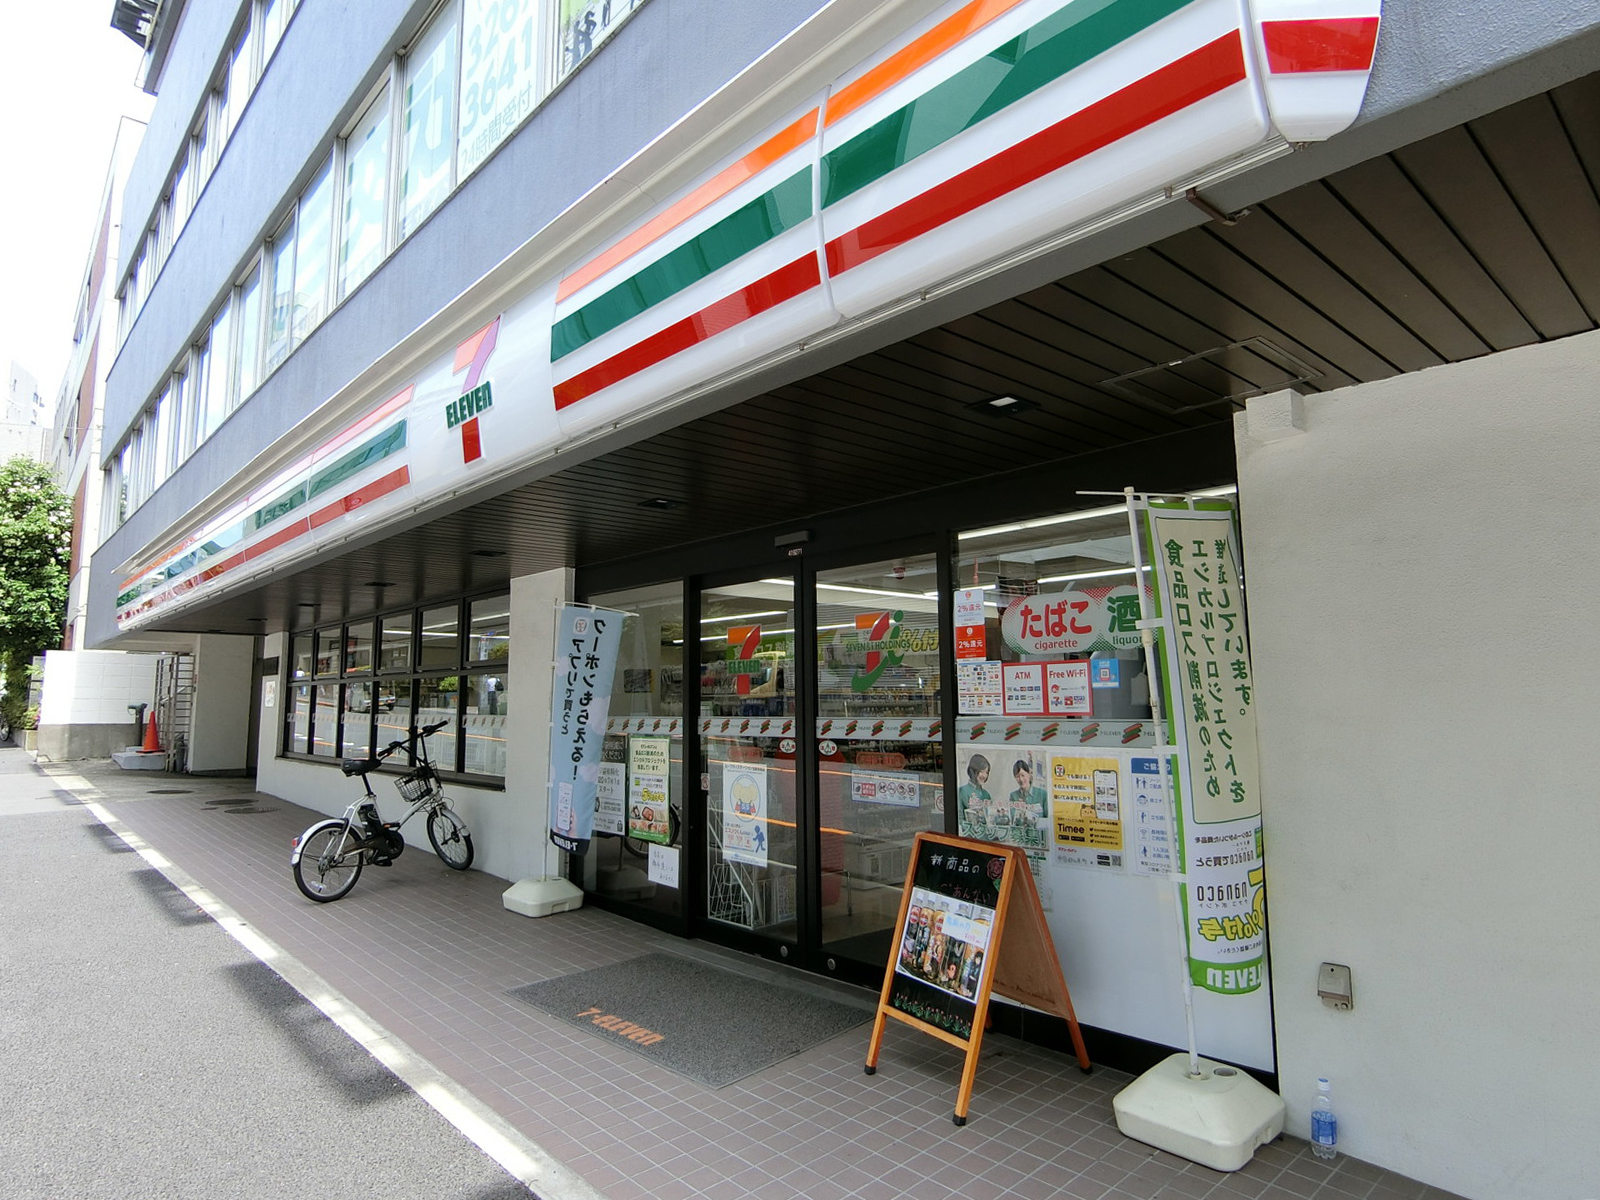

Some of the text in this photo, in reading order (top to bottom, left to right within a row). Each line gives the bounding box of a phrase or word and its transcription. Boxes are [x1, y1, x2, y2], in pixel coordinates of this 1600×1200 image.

[462, 15, 532, 138] 3641
[1020, 599, 1092, 639] たばこ
[1107, 594, 1142, 633] 酒
[1034, 639, 1078, 651] cigarette
[1014, 671, 1031, 680] ATM
[1049, 669, 1086, 679] Free Wi-Fi
[1057, 823, 1085, 834] Timee
[930, 853, 980, 873] 新商品の
